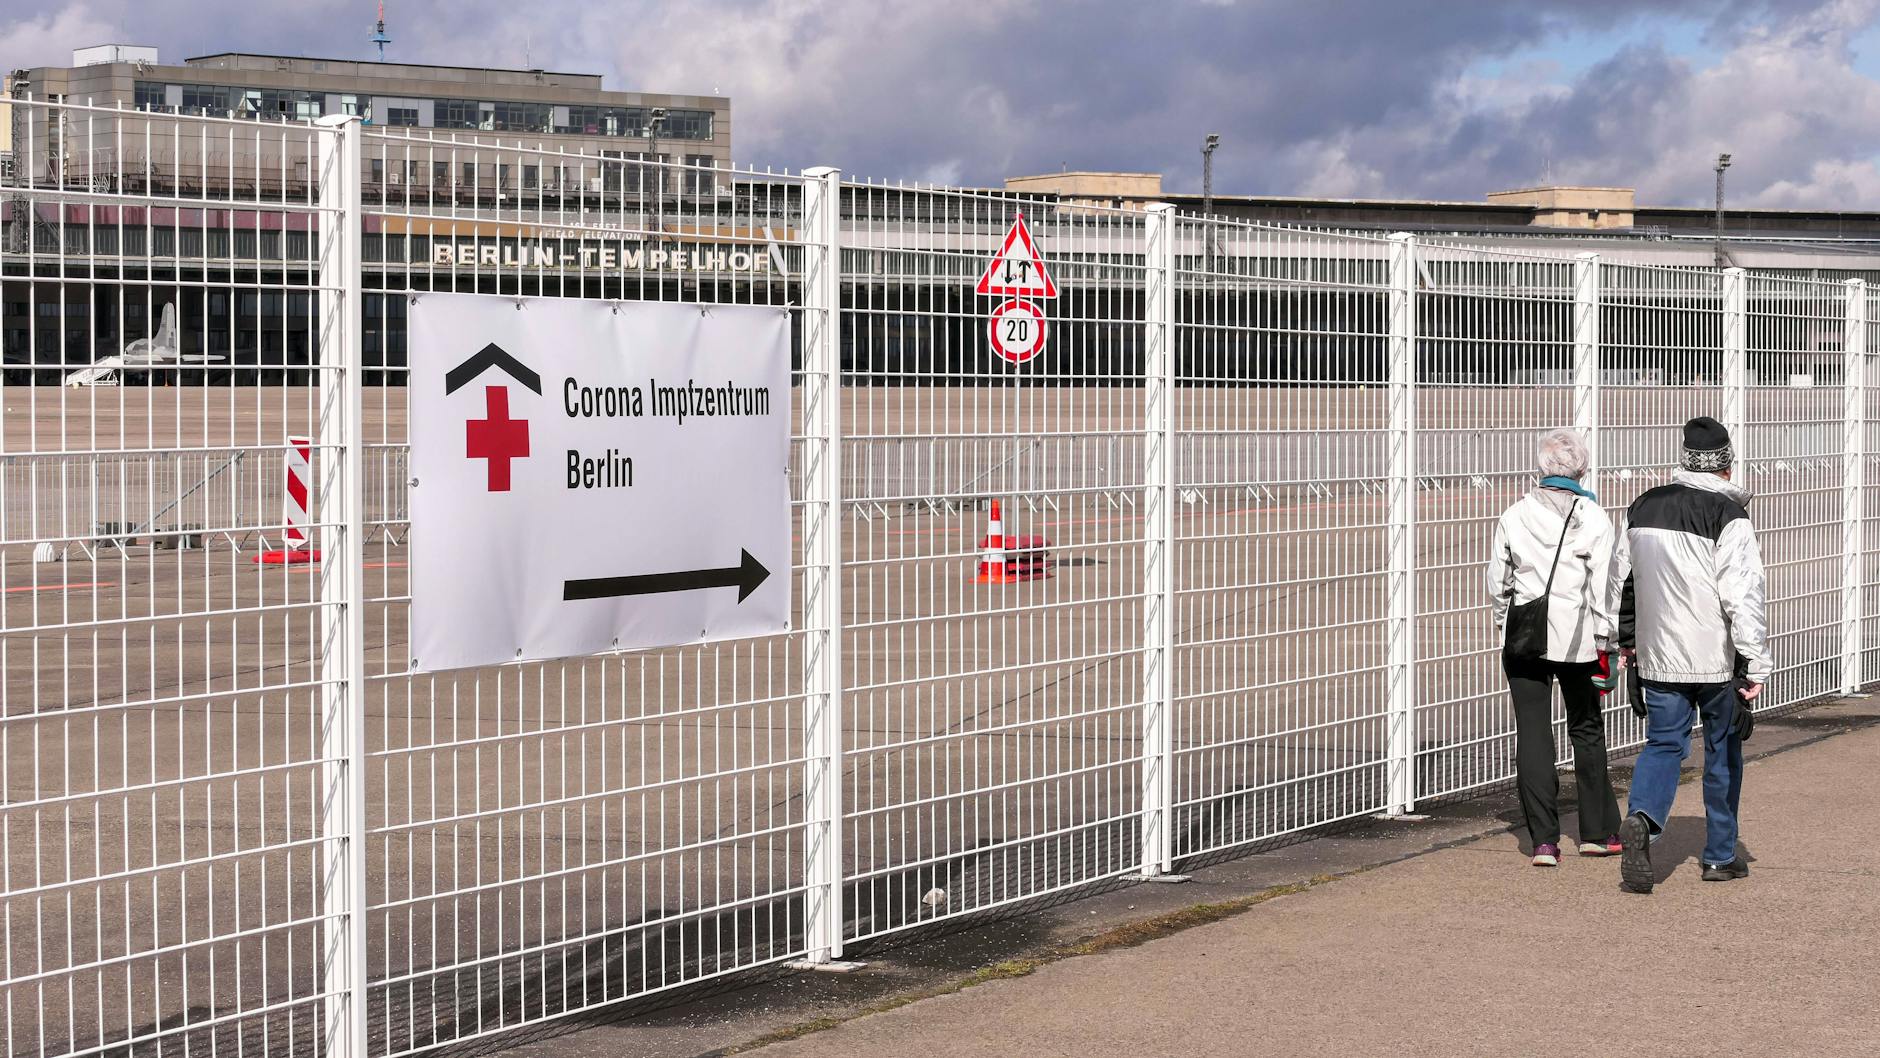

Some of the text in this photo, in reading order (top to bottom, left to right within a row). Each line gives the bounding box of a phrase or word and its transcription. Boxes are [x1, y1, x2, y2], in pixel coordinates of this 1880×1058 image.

[545, 230, 641, 240] FIELD ELEVATON
[434, 243, 769, 271] BERLIN-TEMPELHOF
[1006, 319, 1028, 342] 20
[564, 377, 770, 425] Corona Impfzentrum
[567, 449, 633, 489] Berlin
